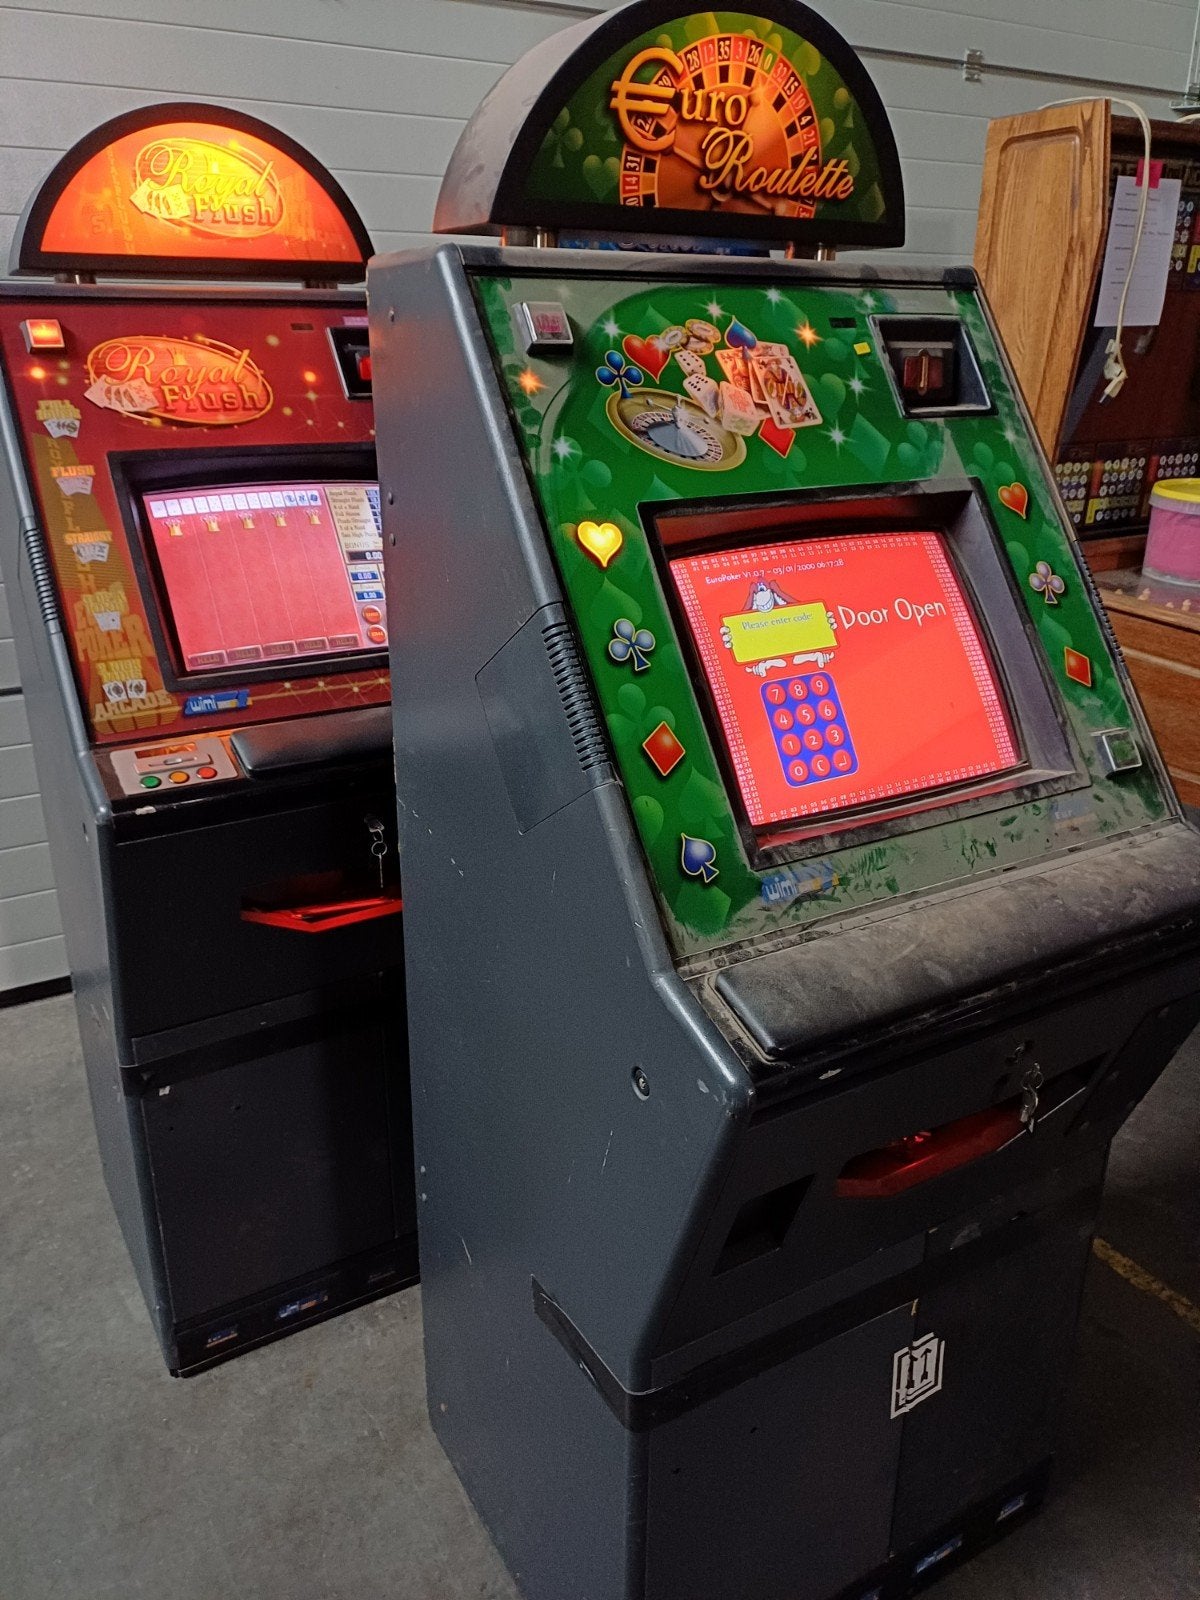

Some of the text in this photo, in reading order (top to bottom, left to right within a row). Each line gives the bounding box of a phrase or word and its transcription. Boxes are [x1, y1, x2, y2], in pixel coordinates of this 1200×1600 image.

[703, 43, 714, 63] 12
[718, 40, 731, 60] 35
[735, 41, 743, 59] 3
[747, 44, 762, 65] 26
[686, 50, 700, 71] 28
[763, 53, 773, 71] 0
[784, 76, 799, 95] 15
[800, 115, 812, 126] 4
[803, 130, 816, 145] 21
[625, 155, 641, 171] 31
[700, 126, 854, 199] Roulette
[145, 144, 274, 211] Royal
[624, 176, 639, 190] 14
[193, 194, 277, 225] Flush
[98, 343, 250, 400] Royal
[161, 384, 265, 411] Flush
[50, 465, 95, 477] FLUSH
[705, 574, 741, 584] EuroPoker
[742, 621, 769, 630] Please
[771, 616, 791, 626] enter
[837, 597, 947, 630] Door Open
[772, 680, 823, 700] 7 8 9
[94, 689, 172, 719] ARCADE
[189, 694, 217, 712] wimi
[780, 704, 832, 725] 4 5 6
[788, 730, 839, 750] 1 2 3
[794, 766, 803, 776] 0
[765, 876, 797, 900] wimi
